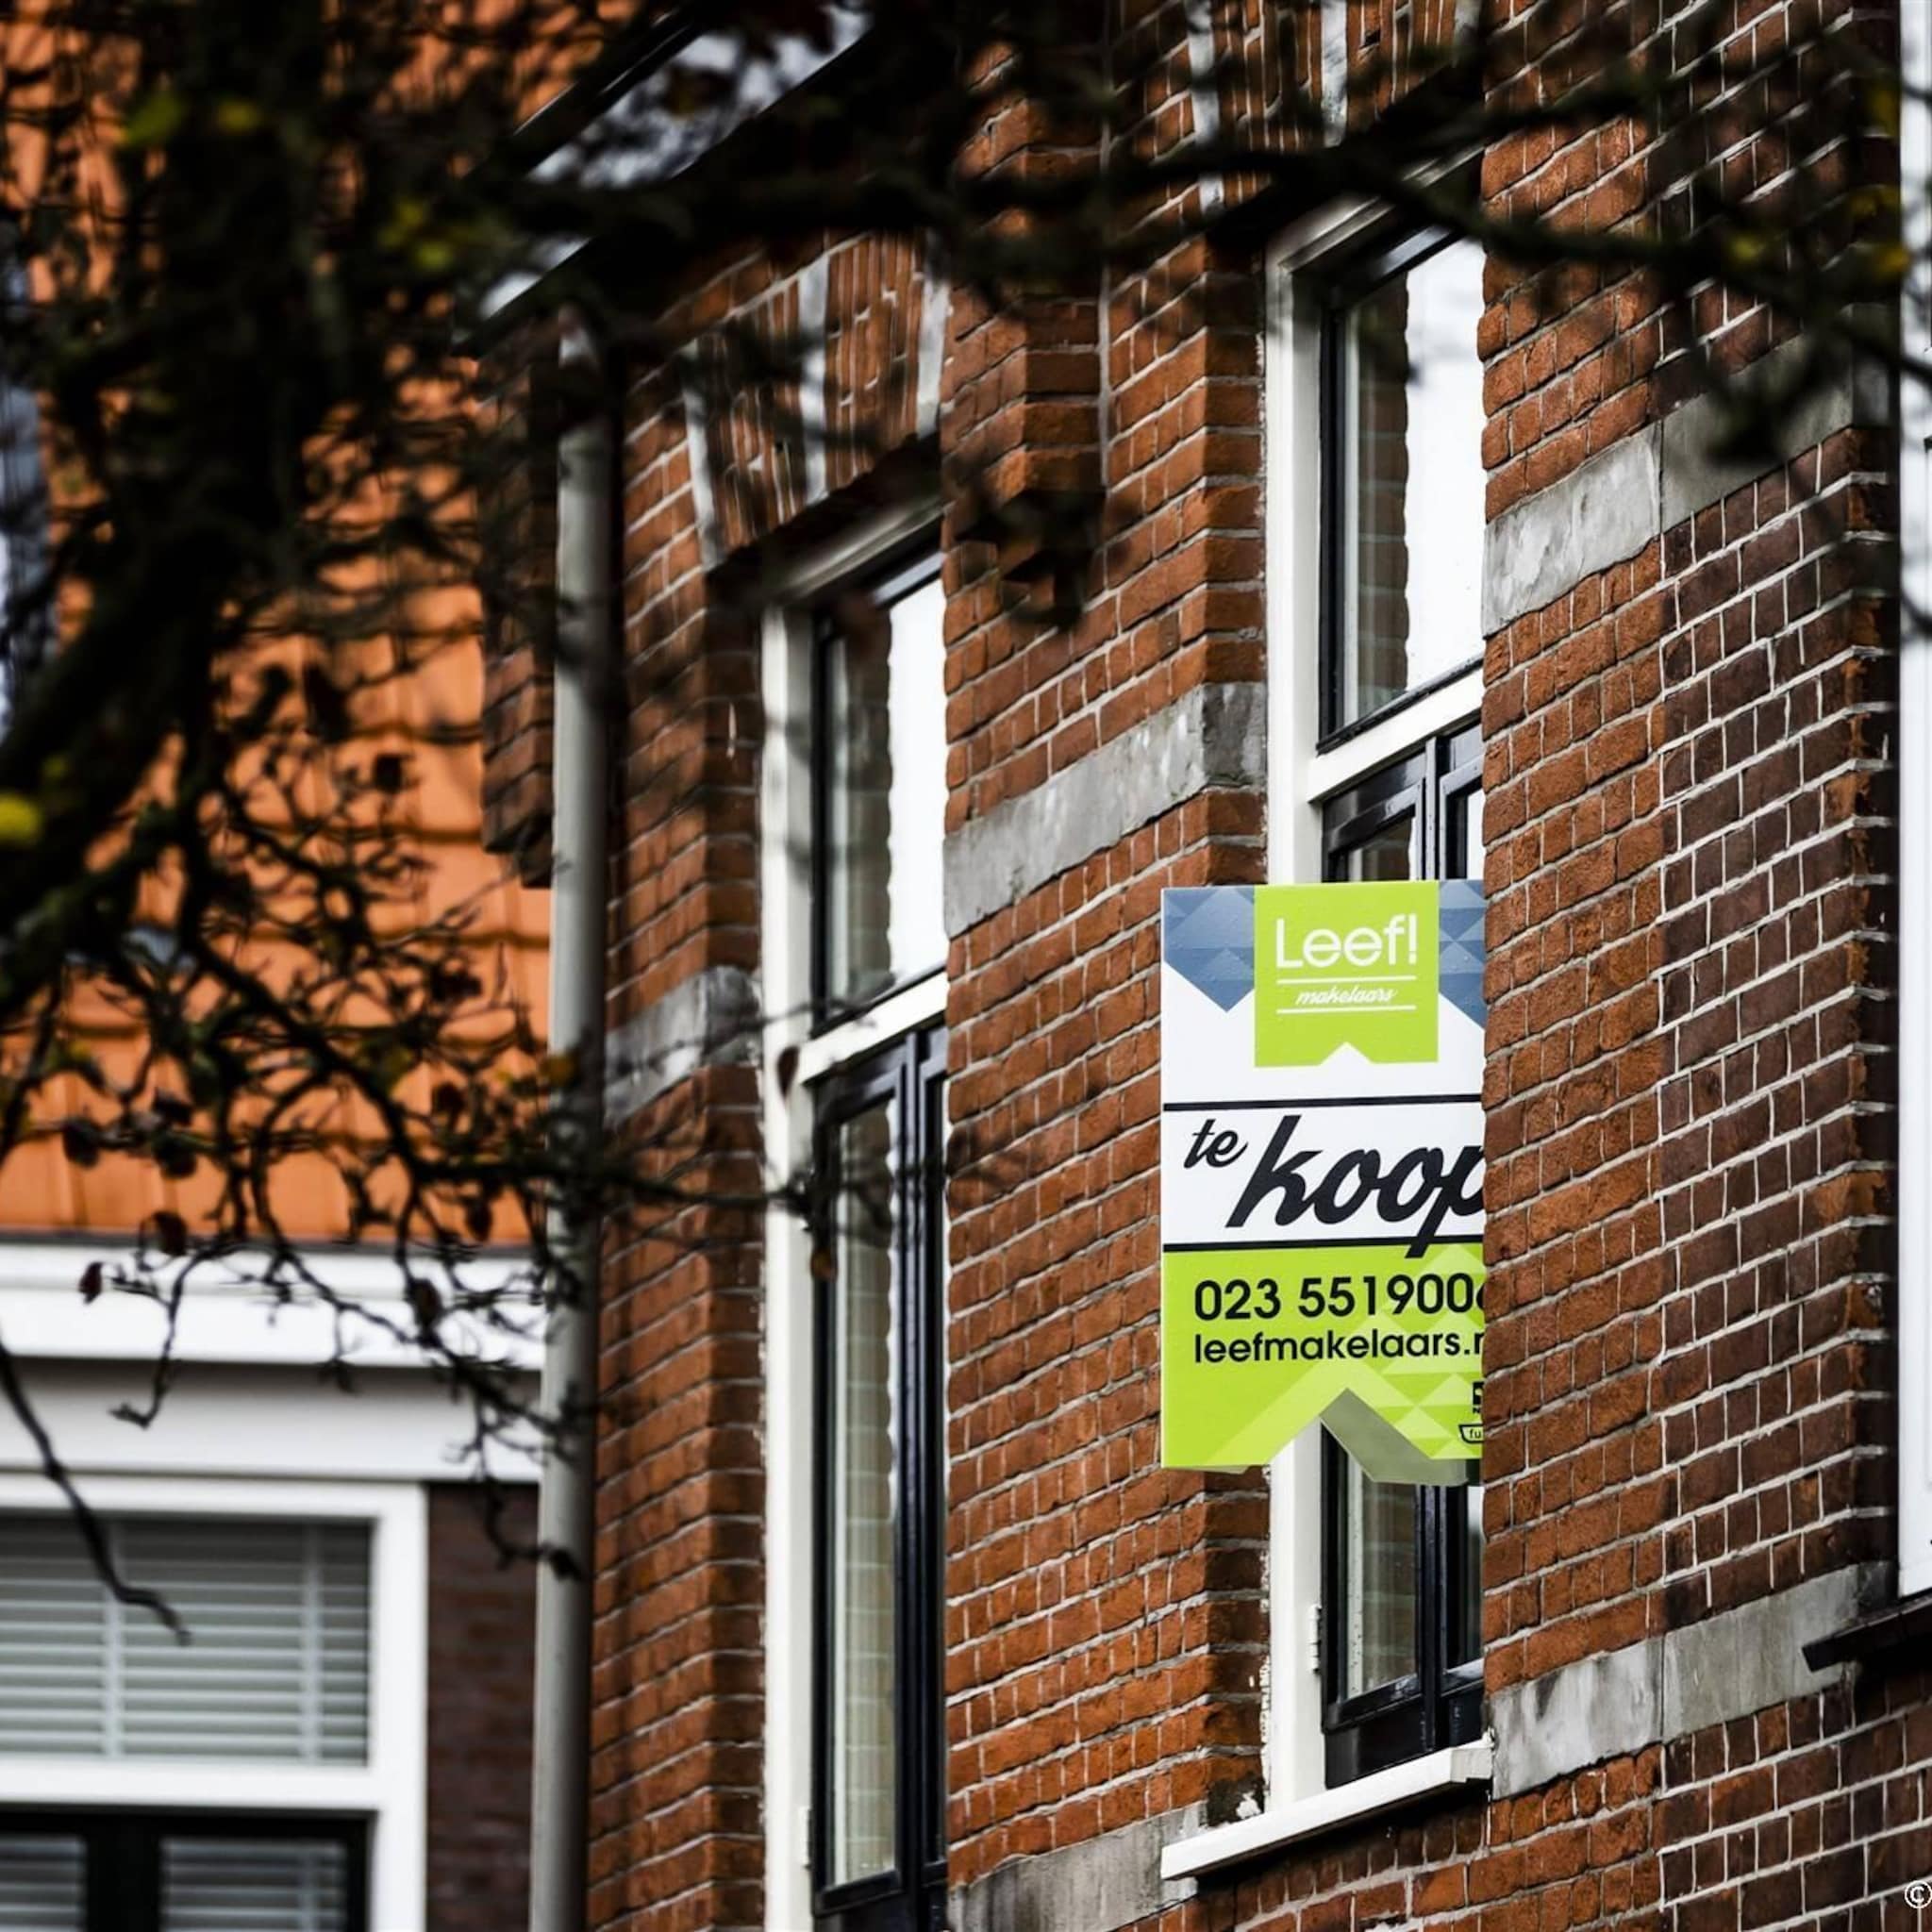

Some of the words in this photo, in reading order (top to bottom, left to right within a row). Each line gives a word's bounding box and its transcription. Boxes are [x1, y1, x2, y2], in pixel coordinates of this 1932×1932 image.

[1275, 913, 1417, 969] Leef!
[1294, 985, 1398, 1006] makelaars
[1183, 1119, 1249, 1170] te
[1224, 1114, 1485, 1259] koop
[1194, 1277, 1281, 1322] 023
[1297, 1273, 1485, 1318] 551900
